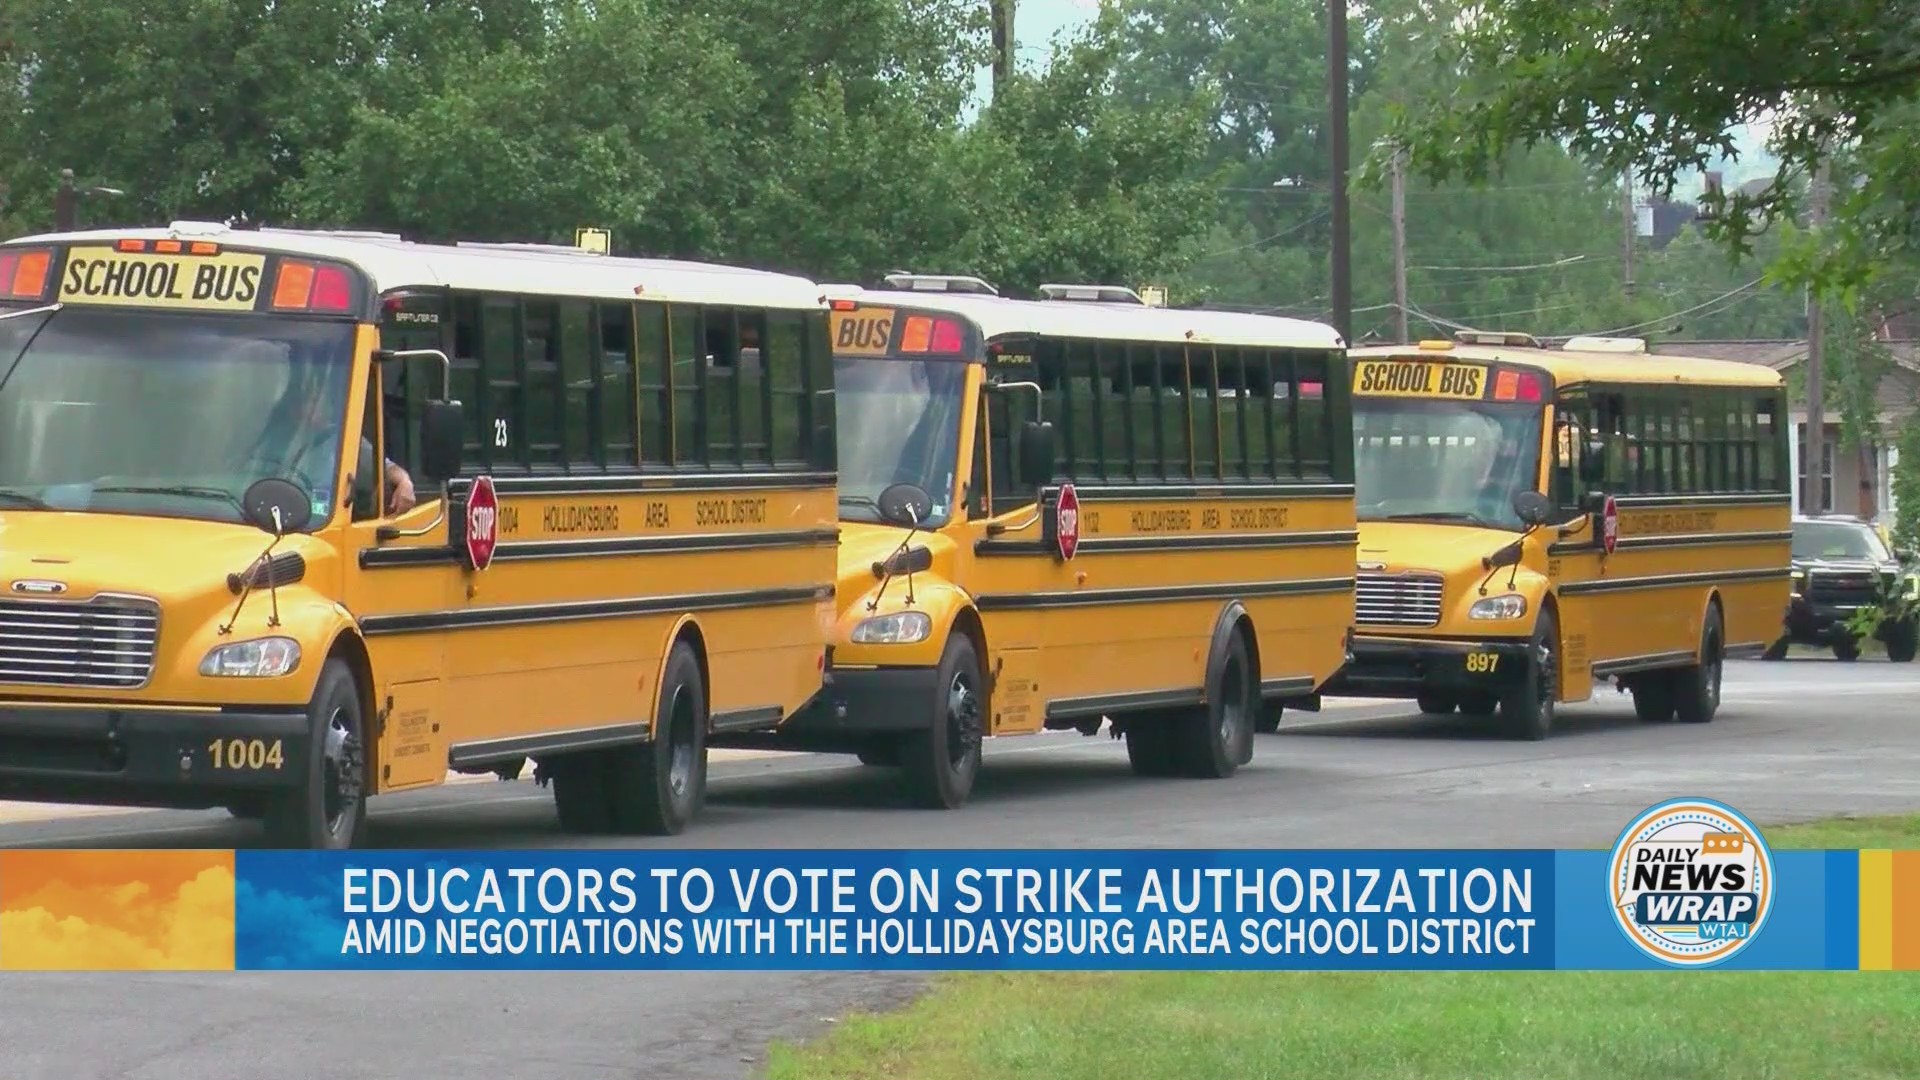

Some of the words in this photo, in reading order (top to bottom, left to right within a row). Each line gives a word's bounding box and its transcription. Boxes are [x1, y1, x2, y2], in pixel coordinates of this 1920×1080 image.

[63, 259, 183, 298] SCHOOL
[192, 264, 260, 302] BUS
[837, 317, 891, 349] BUS
[1360, 363, 1433, 393] SCHOOL
[1439, 367, 1480, 396] BUS
[494, 418, 508, 447] 23
[471, 506, 494, 541] STOP
[498, 506, 519, 534] 1004
[543, 504, 619, 532] HOLLIDAYSBURG
[645, 502, 670, 529] AREA
[696, 500, 731, 527] SCHOOL
[731, 499, 767, 525] DISTRICT
[1201, 508, 1221, 530] AREA
[1230, 508, 1258, 529] SCHOOL
[1466, 653, 1499, 673] 897
[207, 738, 284, 770] 1004
